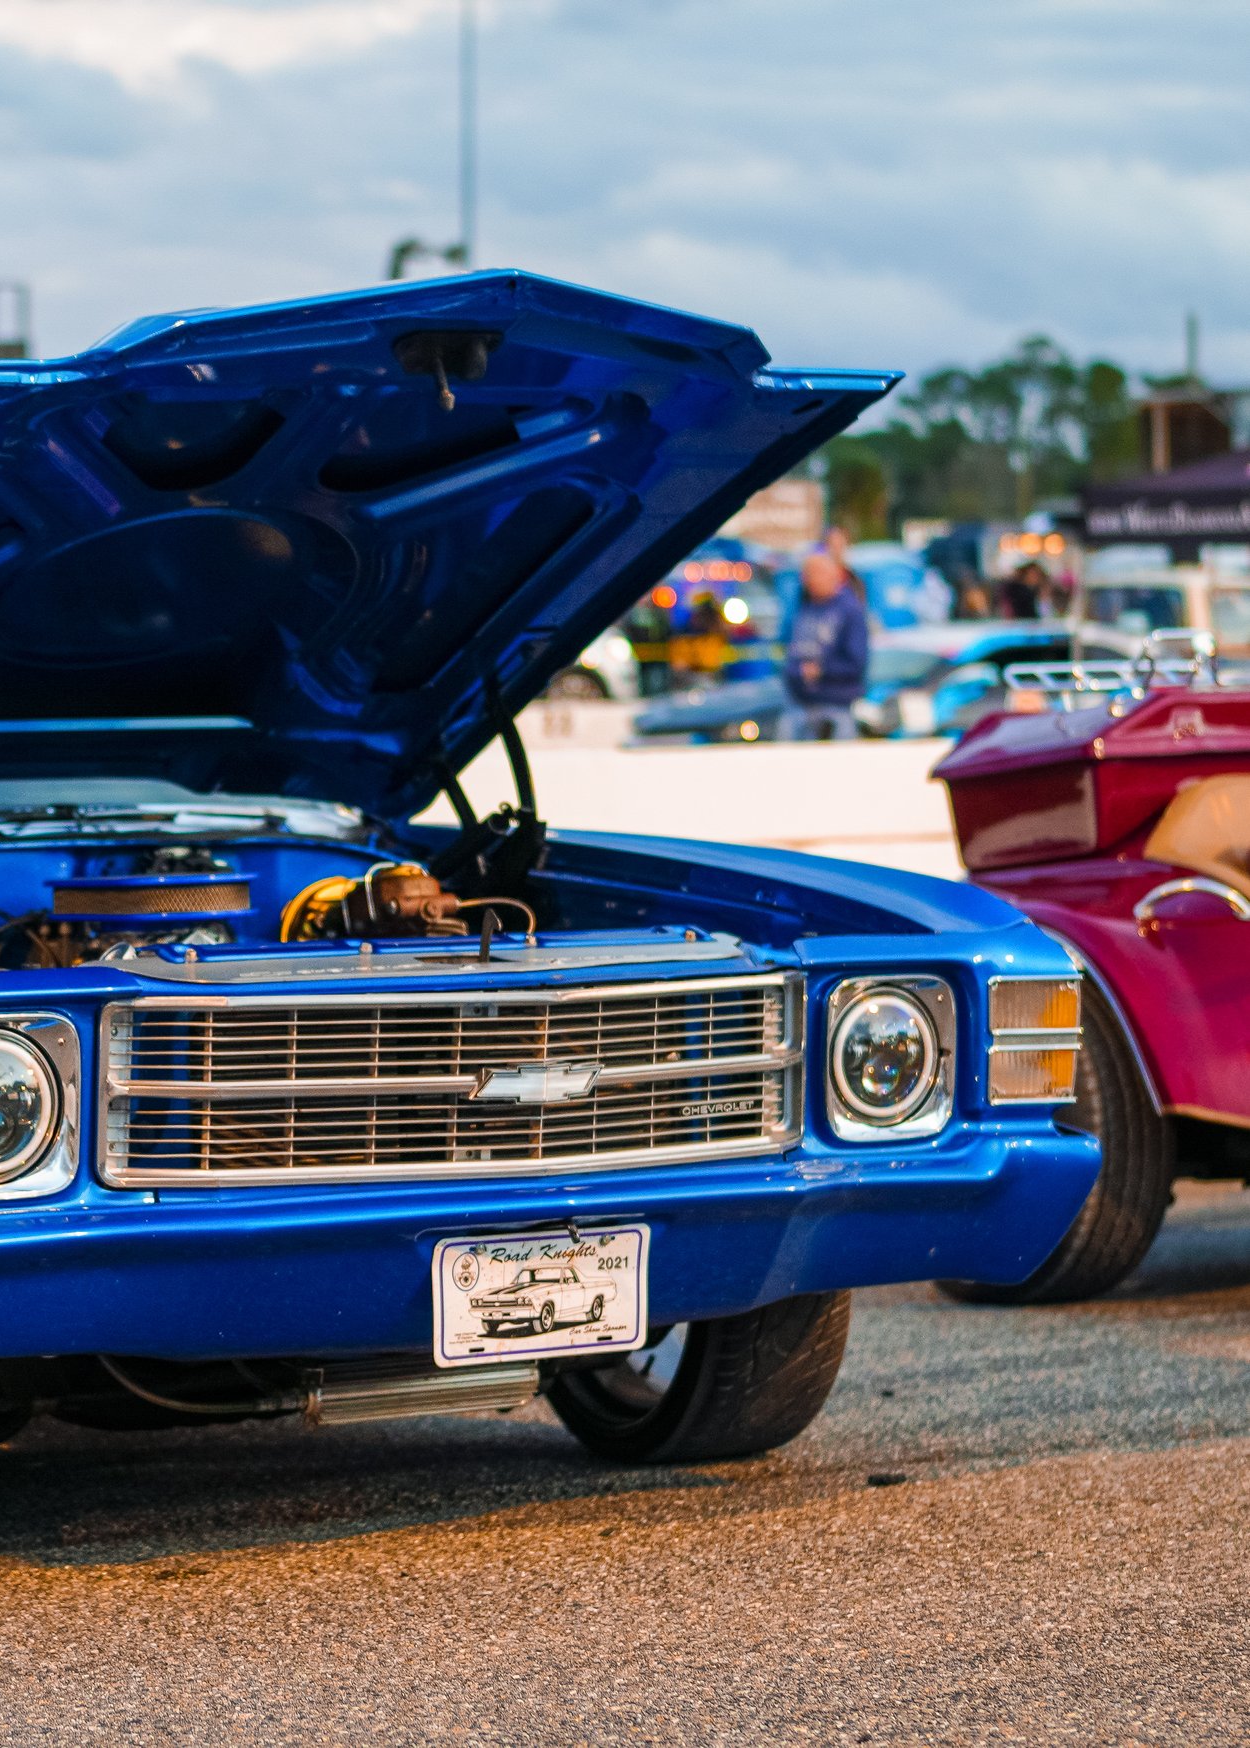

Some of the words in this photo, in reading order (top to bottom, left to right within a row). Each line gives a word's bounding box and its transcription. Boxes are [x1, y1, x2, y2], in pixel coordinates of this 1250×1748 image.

[682, 1100, 754, 1116] CHEVROLET
[489, 1247, 532, 1264] Road
[539, 1241, 597, 1263] Knights
[597, 1256, 628, 1270] 2021
